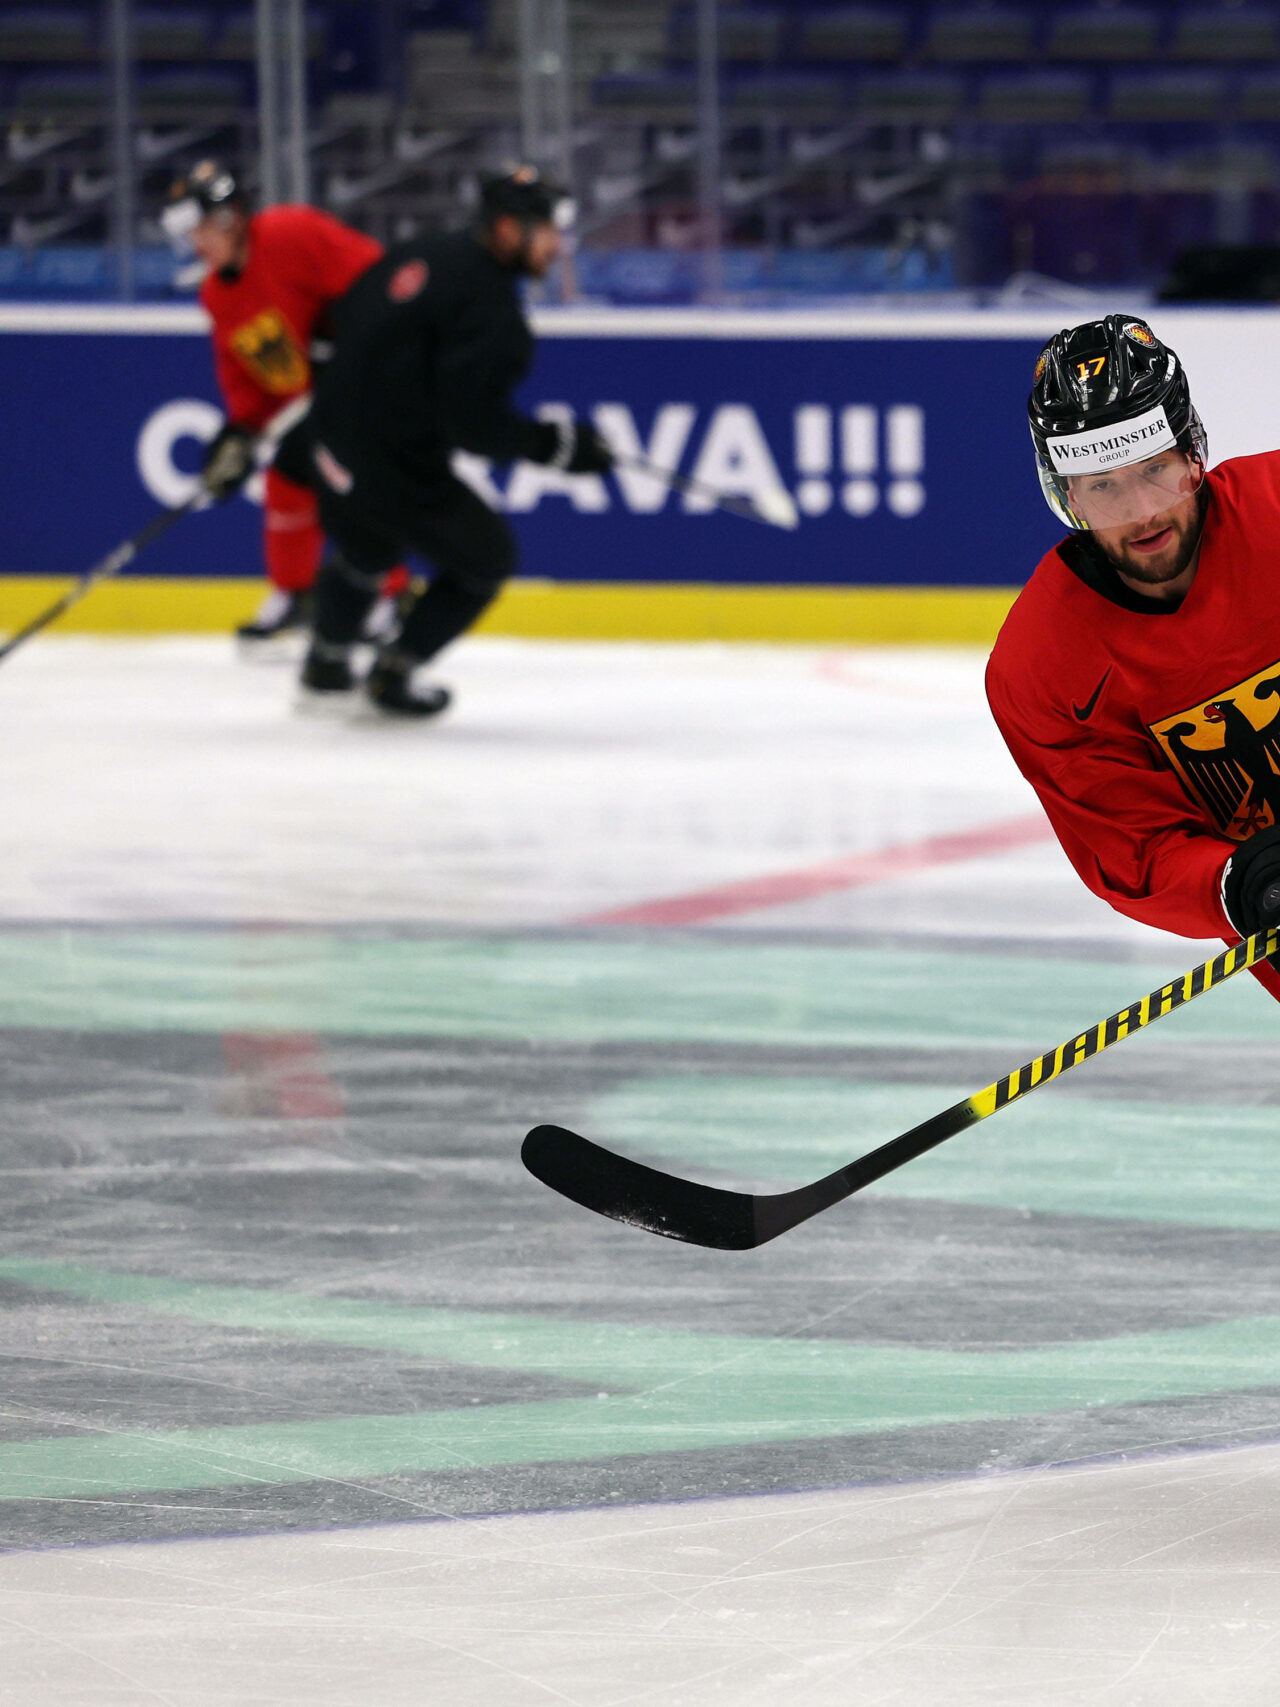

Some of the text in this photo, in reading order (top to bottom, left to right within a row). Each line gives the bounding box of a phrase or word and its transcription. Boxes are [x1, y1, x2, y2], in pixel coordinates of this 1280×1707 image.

[1076, 356, 1106, 382] 17
[1052, 419, 1166, 460] WESTMINSTER
[1099, 450, 1131, 464] GROUP
